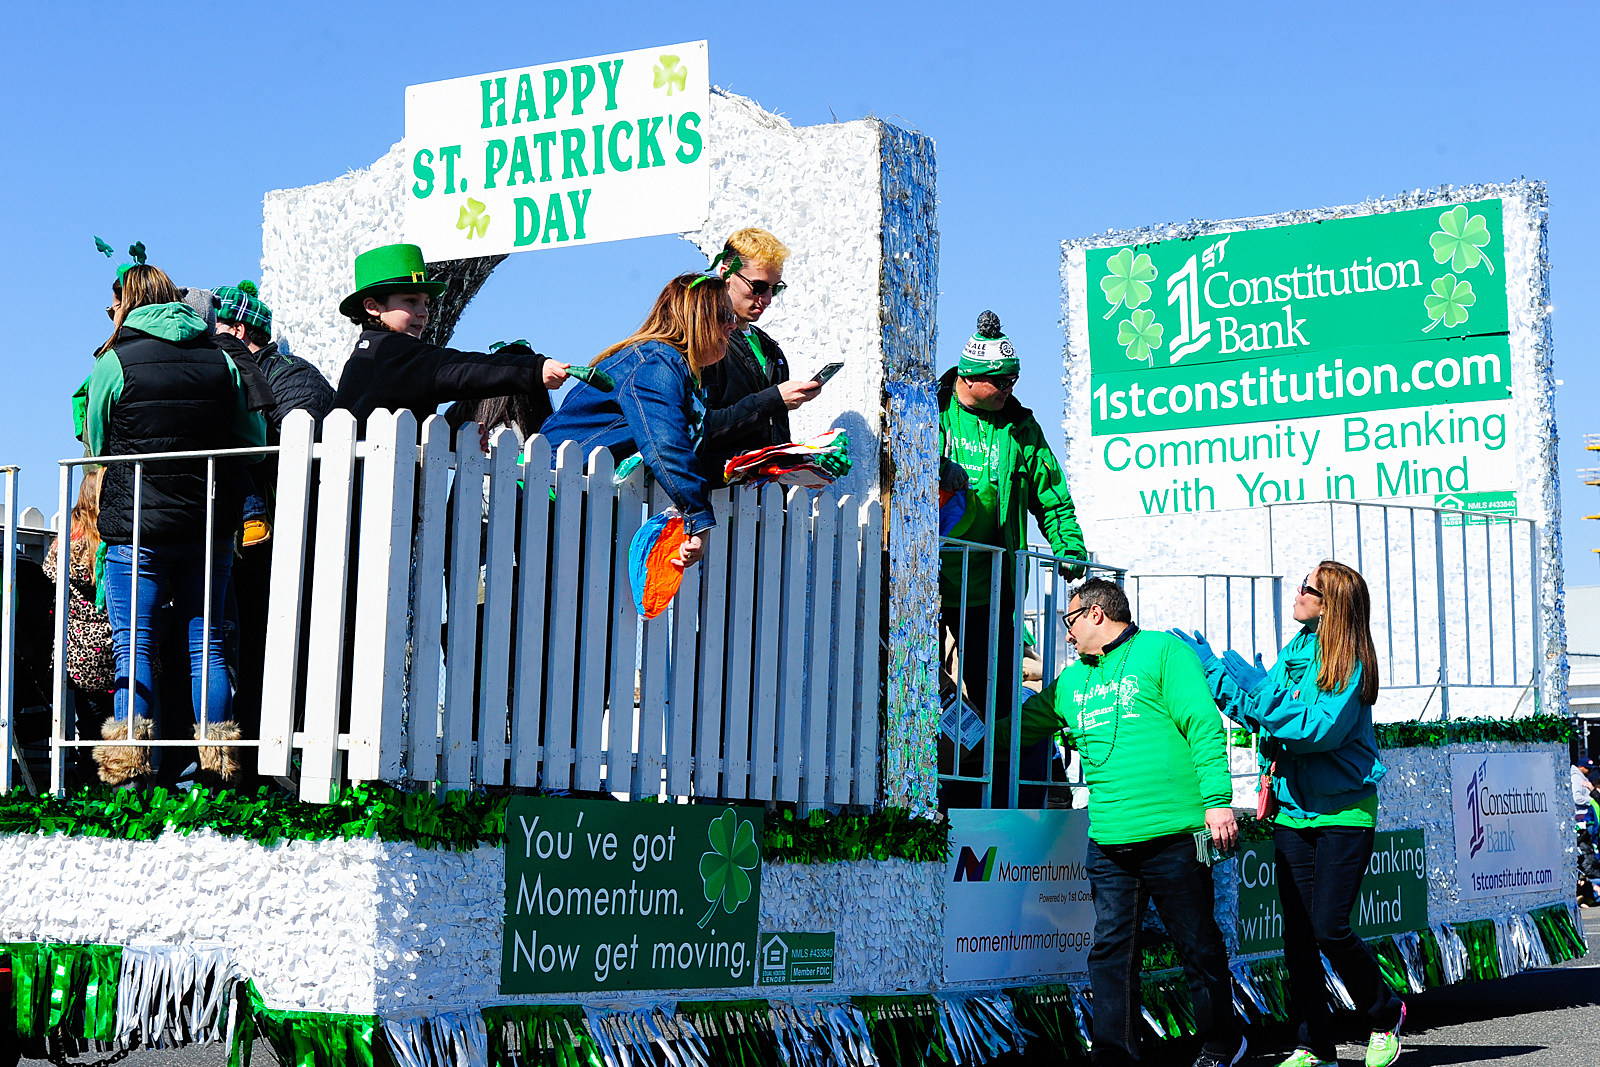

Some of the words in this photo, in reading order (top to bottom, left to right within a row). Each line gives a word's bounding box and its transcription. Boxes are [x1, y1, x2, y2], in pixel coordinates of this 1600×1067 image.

[480, 58, 624, 129] HAPPY
[412, 144, 468, 199] ST.
[484, 111, 703, 189] PATRICK'S
[513, 188, 592, 247] DAY
[1203, 257, 1423, 310] Constitution
[1218, 305, 1310, 354] Bank
[1092, 353, 1502, 421] 1stconstitution.com
[1103, 423, 1321, 472] Community
[1344, 409, 1506, 453] Banking
[1139, 477, 1216, 515] with
[1238, 470, 1306, 507] You
[1326, 466, 1355, 501] in
[1376, 455, 1470, 497] Mind
[1467, 501, 1488, 509] NMLS
[1480, 786, 1548, 817] Constitution
[519, 811, 618, 861] You've
[632, 825, 676, 873] got
[1363, 836, 1426, 880] anking
[1485, 819, 1516, 854] Bank
[515, 872, 685, 916] Momentum.
[998, 860, 1088, 882] MomentumMo
[1471, 866, 1553, 892] 1stconstitution.com
[1039, 893, 1061, 903] Powered
[1068, 891, 1077, 901] 1st
[1078, 890, 1093, 901] Cons
[1241, 904, 1283, 942] with
[1358, 886, 1402, 927] Mind
[512, 930, 580, 973] Now
[594, 933, 639, 982] get
[651, 928, 751, 979] moving.
[791, 948, 809, 958] NMLS
[809, 948, 833, 958] #433840
[956, 929, 1095, 953] momentummortgage.
[793, 967, 815, 976] Member
[816, 966, 830, 975] FDIC
